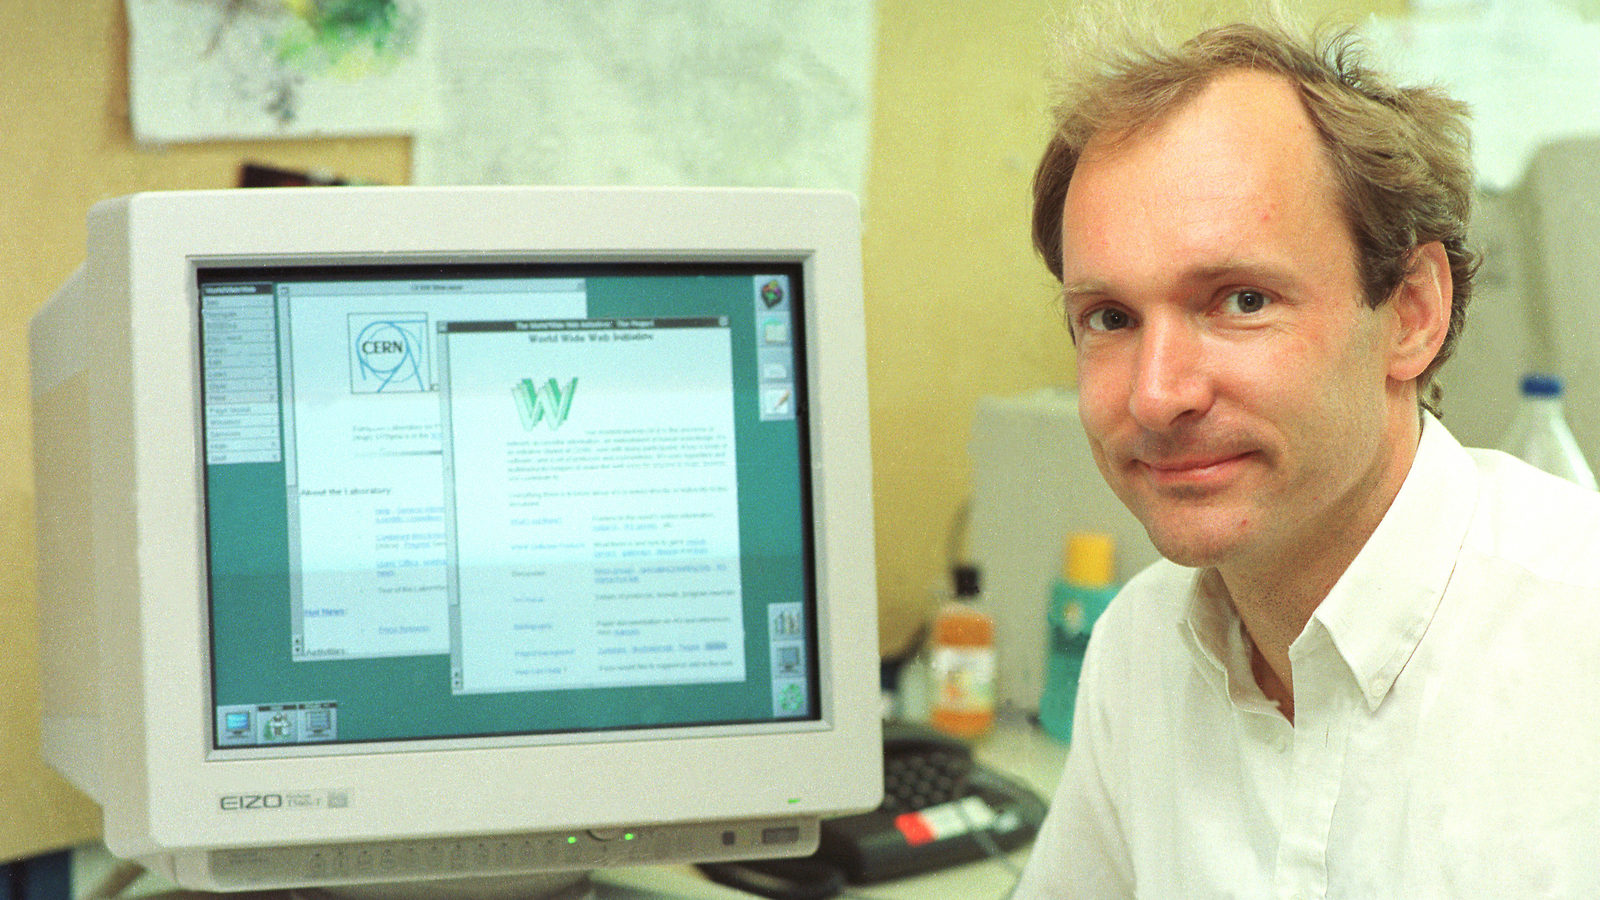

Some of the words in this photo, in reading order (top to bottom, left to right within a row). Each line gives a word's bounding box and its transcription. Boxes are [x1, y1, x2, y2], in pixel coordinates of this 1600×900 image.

[529, 334, 558, 343] World
[561, 333, 585, 343] Wide
[588, 333, 610, 342] Web
[362, 340, 403, 355] CERN
[219, 793, 282, 810] EIZO
